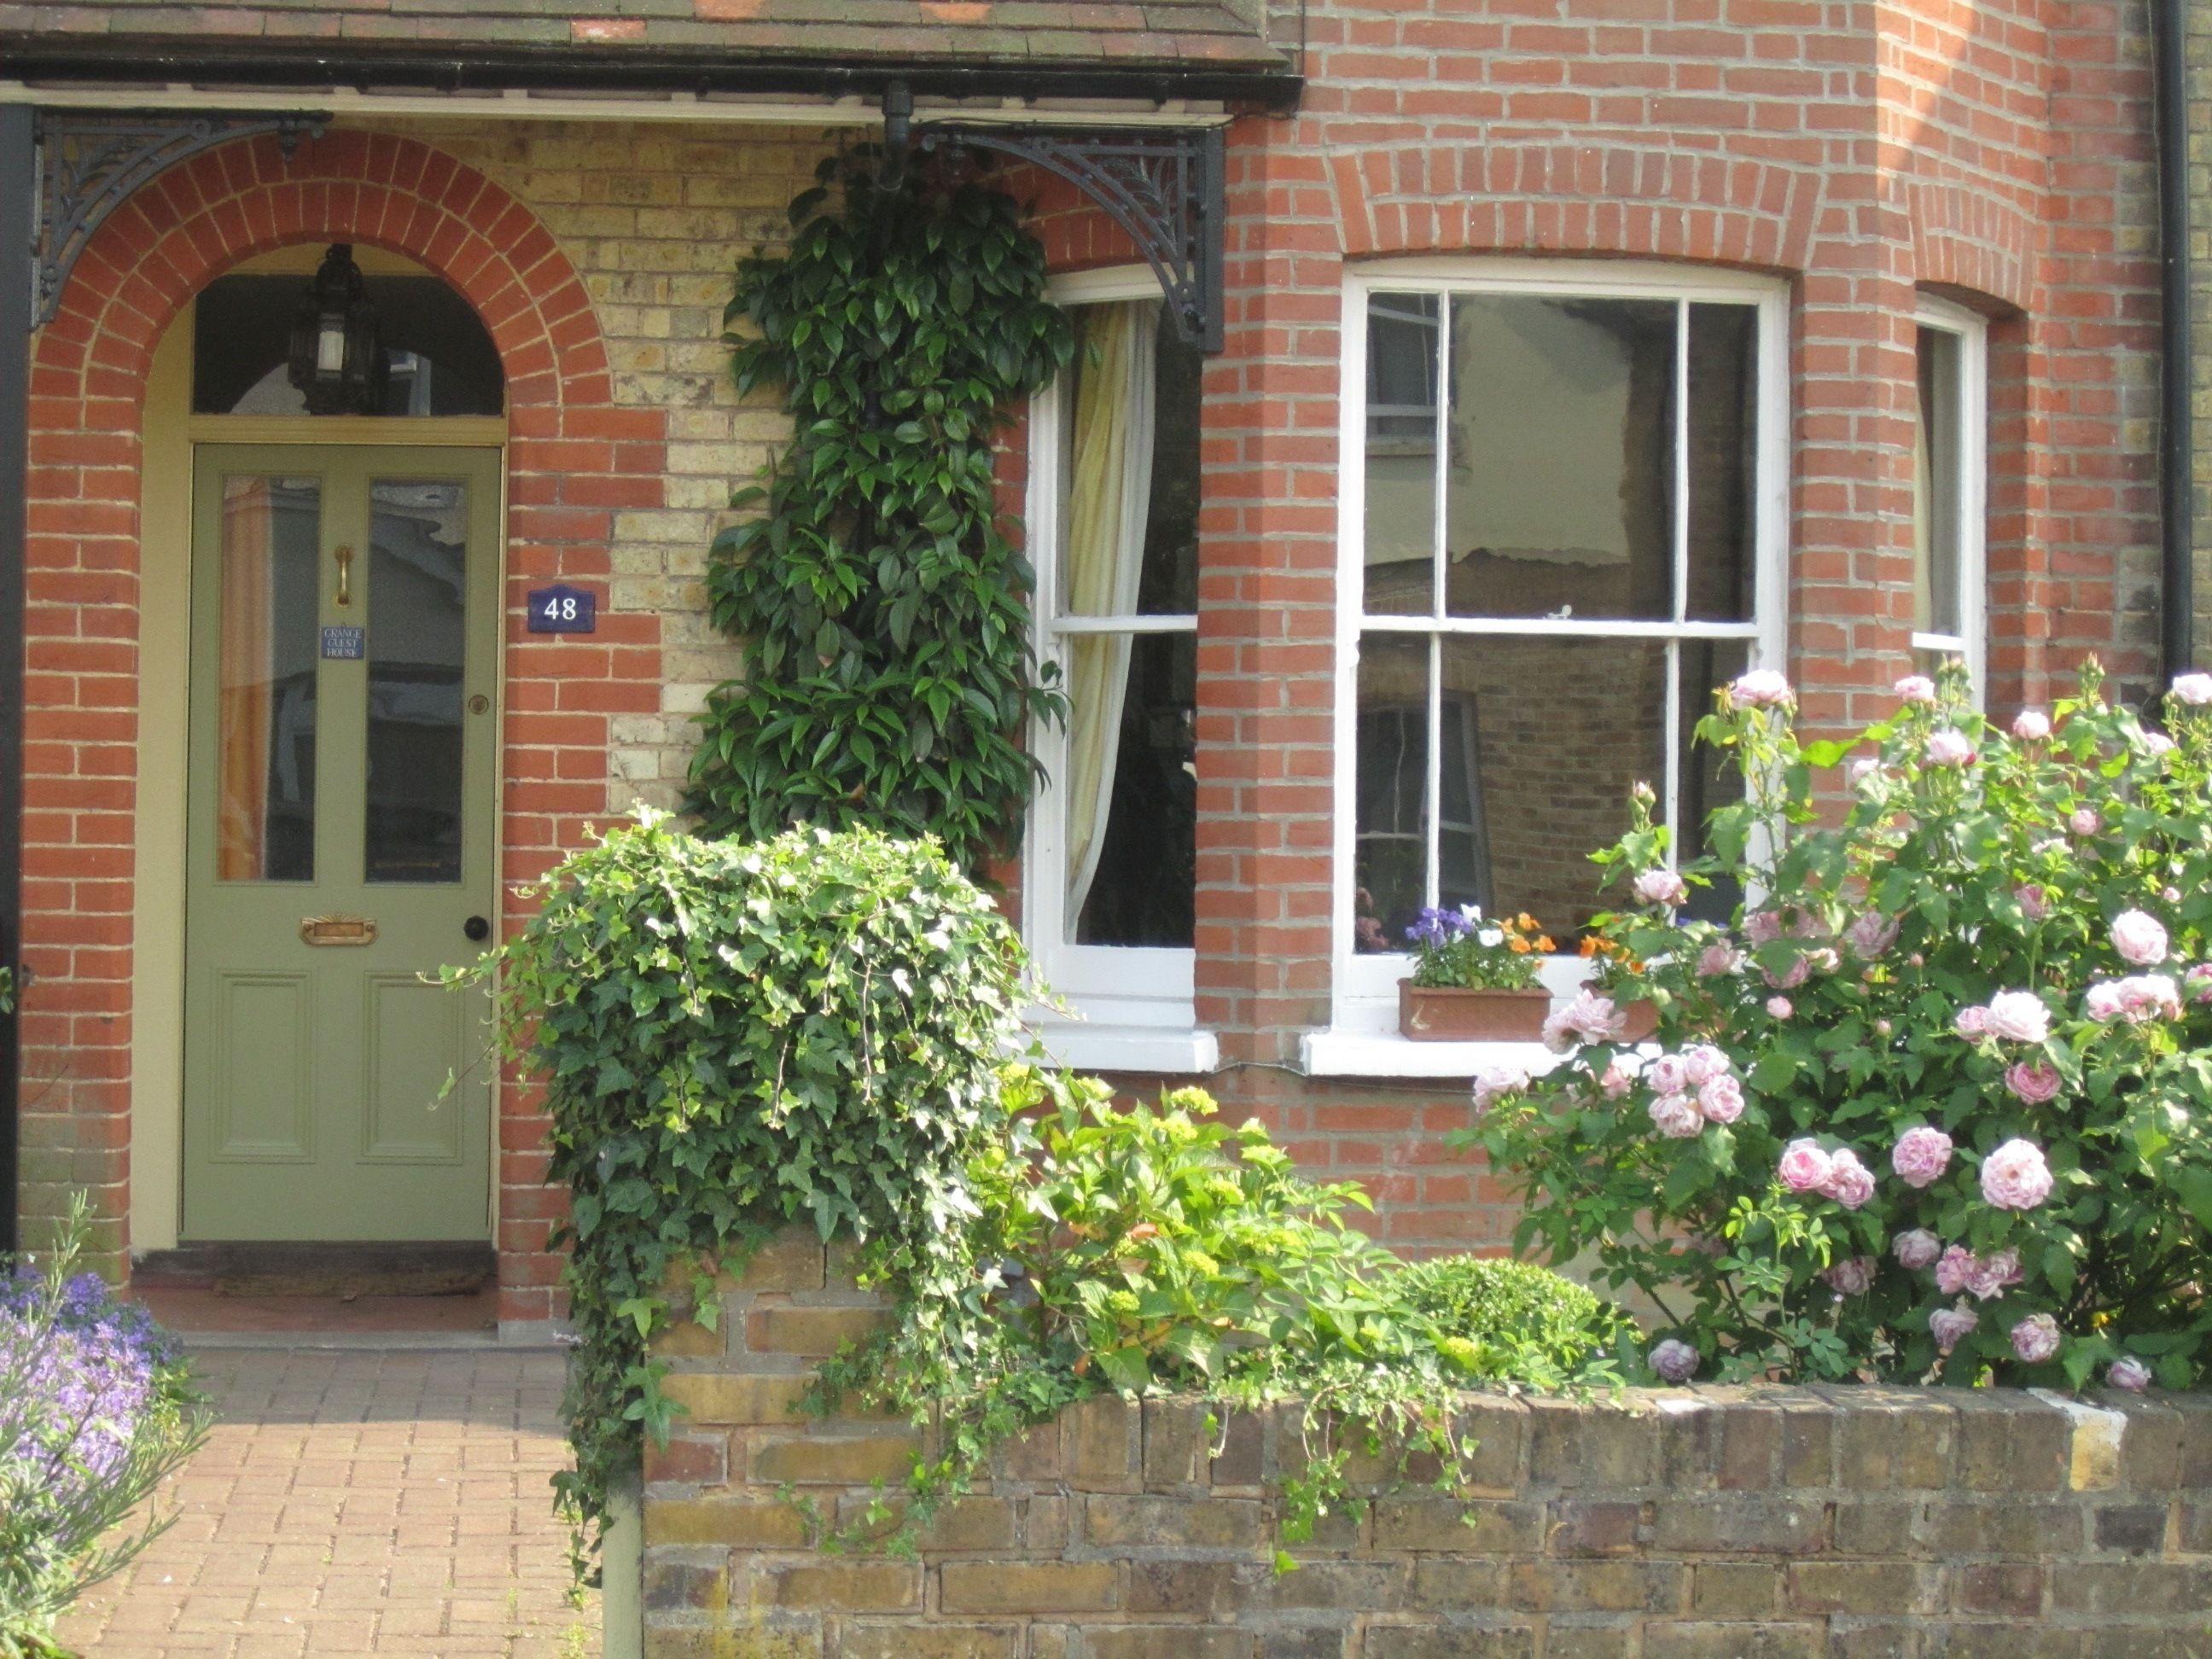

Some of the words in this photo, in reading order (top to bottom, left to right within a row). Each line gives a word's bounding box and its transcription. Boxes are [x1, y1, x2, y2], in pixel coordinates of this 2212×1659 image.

[544, 597, 577, 620] 48
[324, 628, 362, 638] GRANGE
[327, 648, 357, 657] HOUSE
